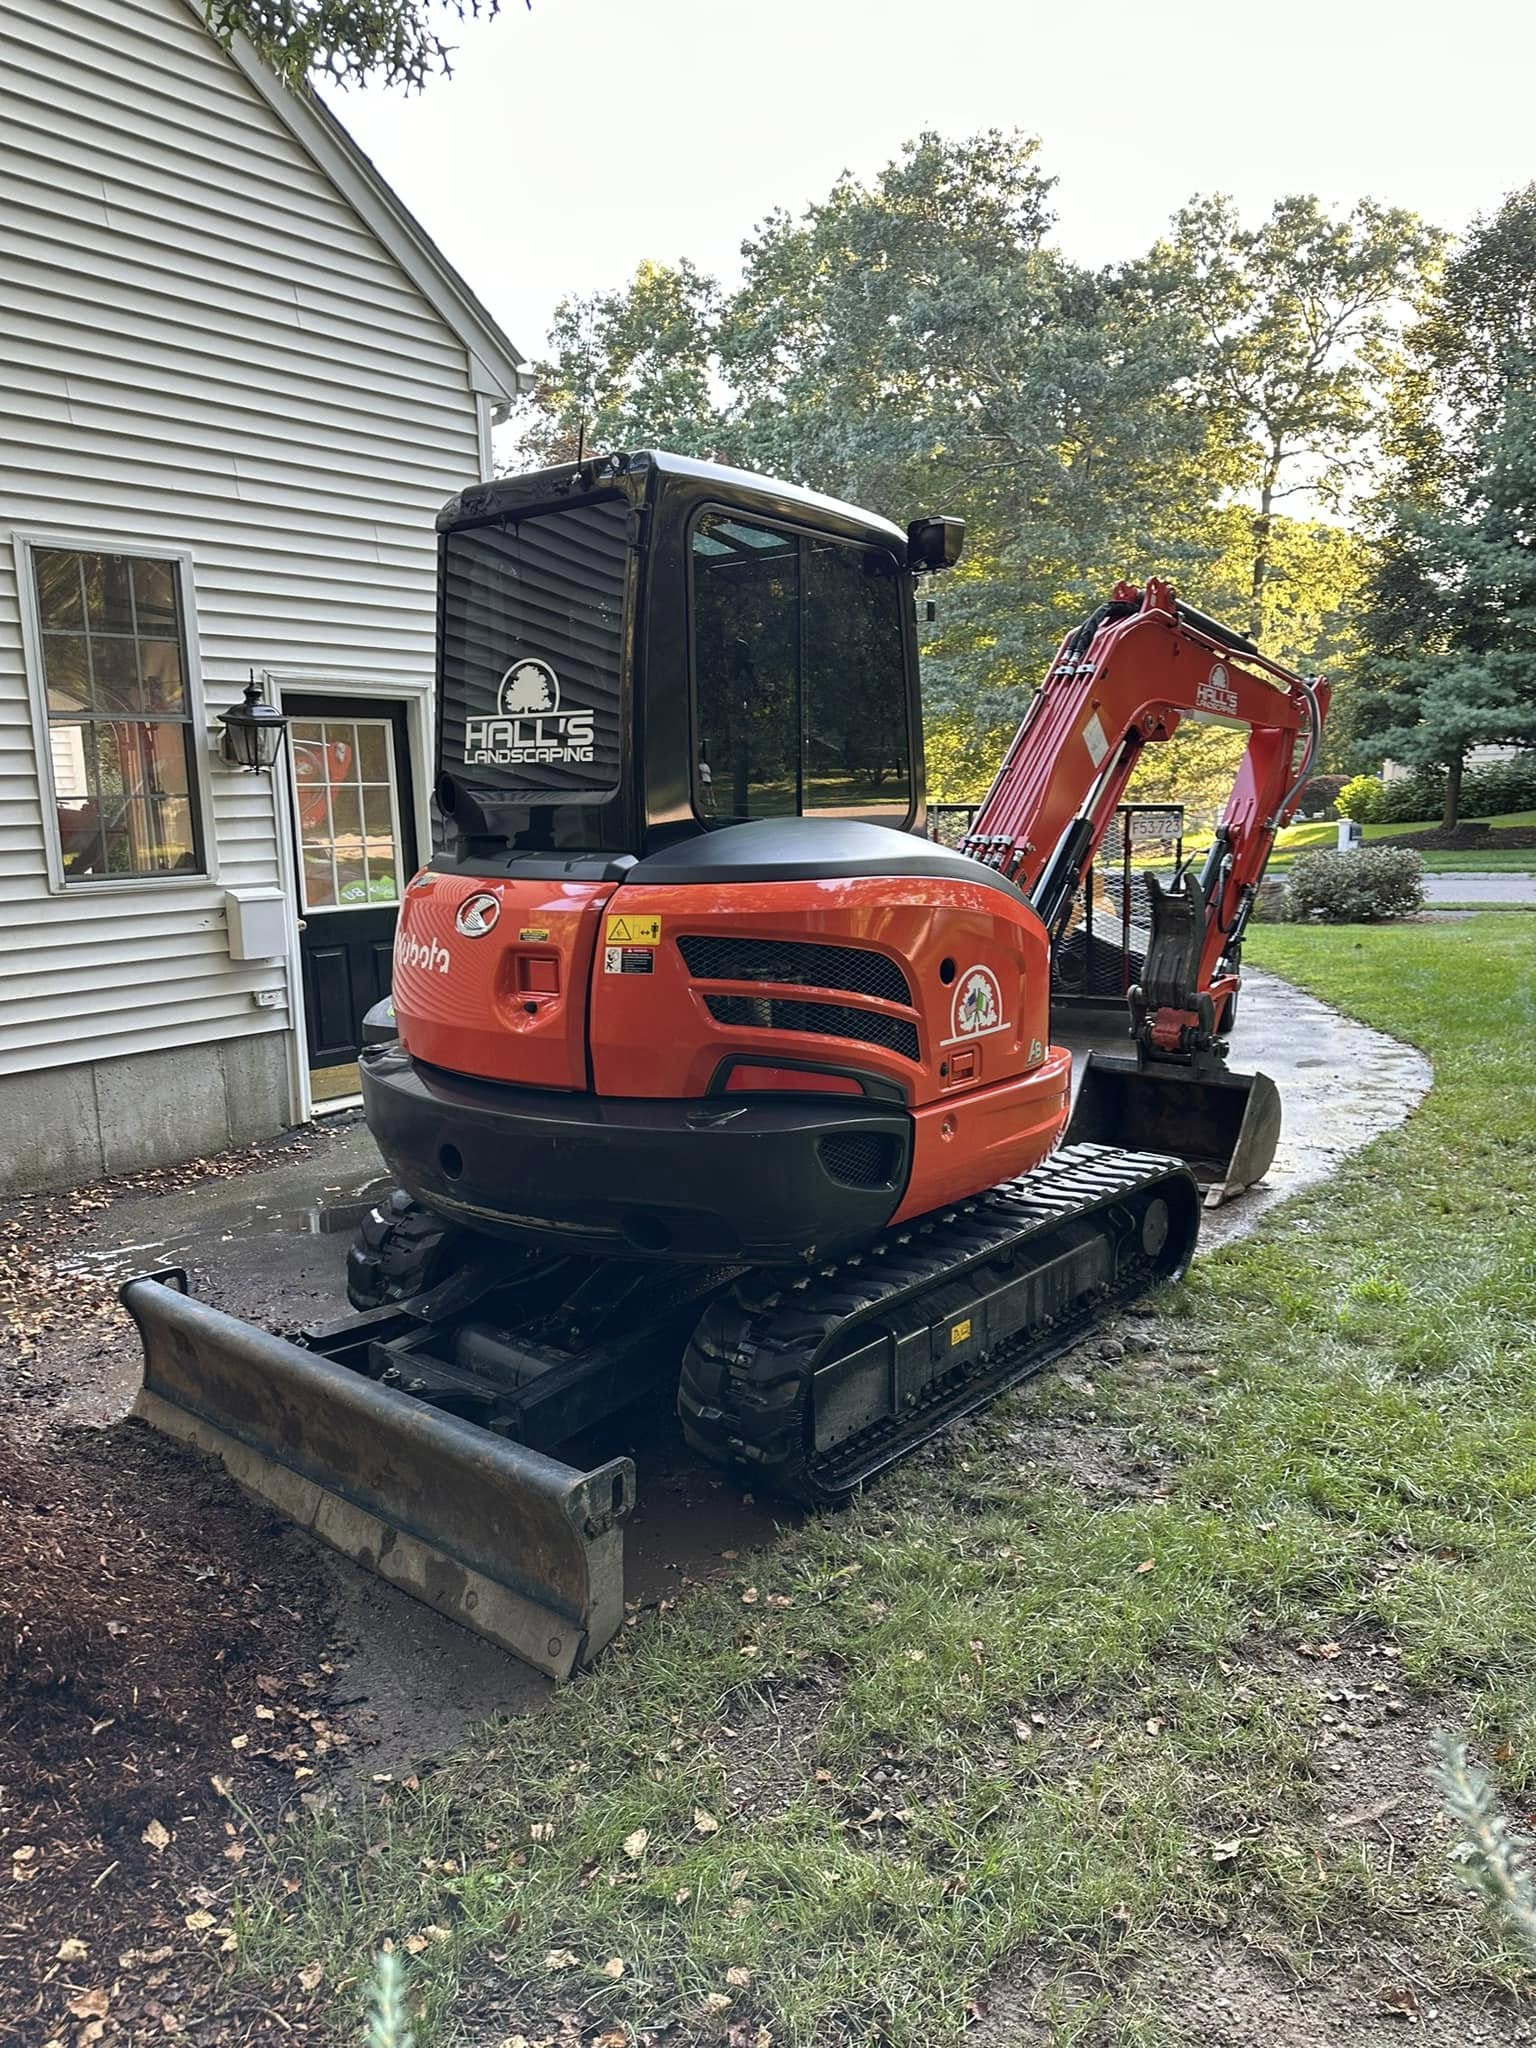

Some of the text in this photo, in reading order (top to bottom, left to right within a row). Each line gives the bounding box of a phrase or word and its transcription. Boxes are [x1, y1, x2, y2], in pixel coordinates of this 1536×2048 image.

[465, 716, 594, 749] HALL'S
[464, 747, 594, 764] LANDSCAPING
[398, 932, 450, 974] Kubota
